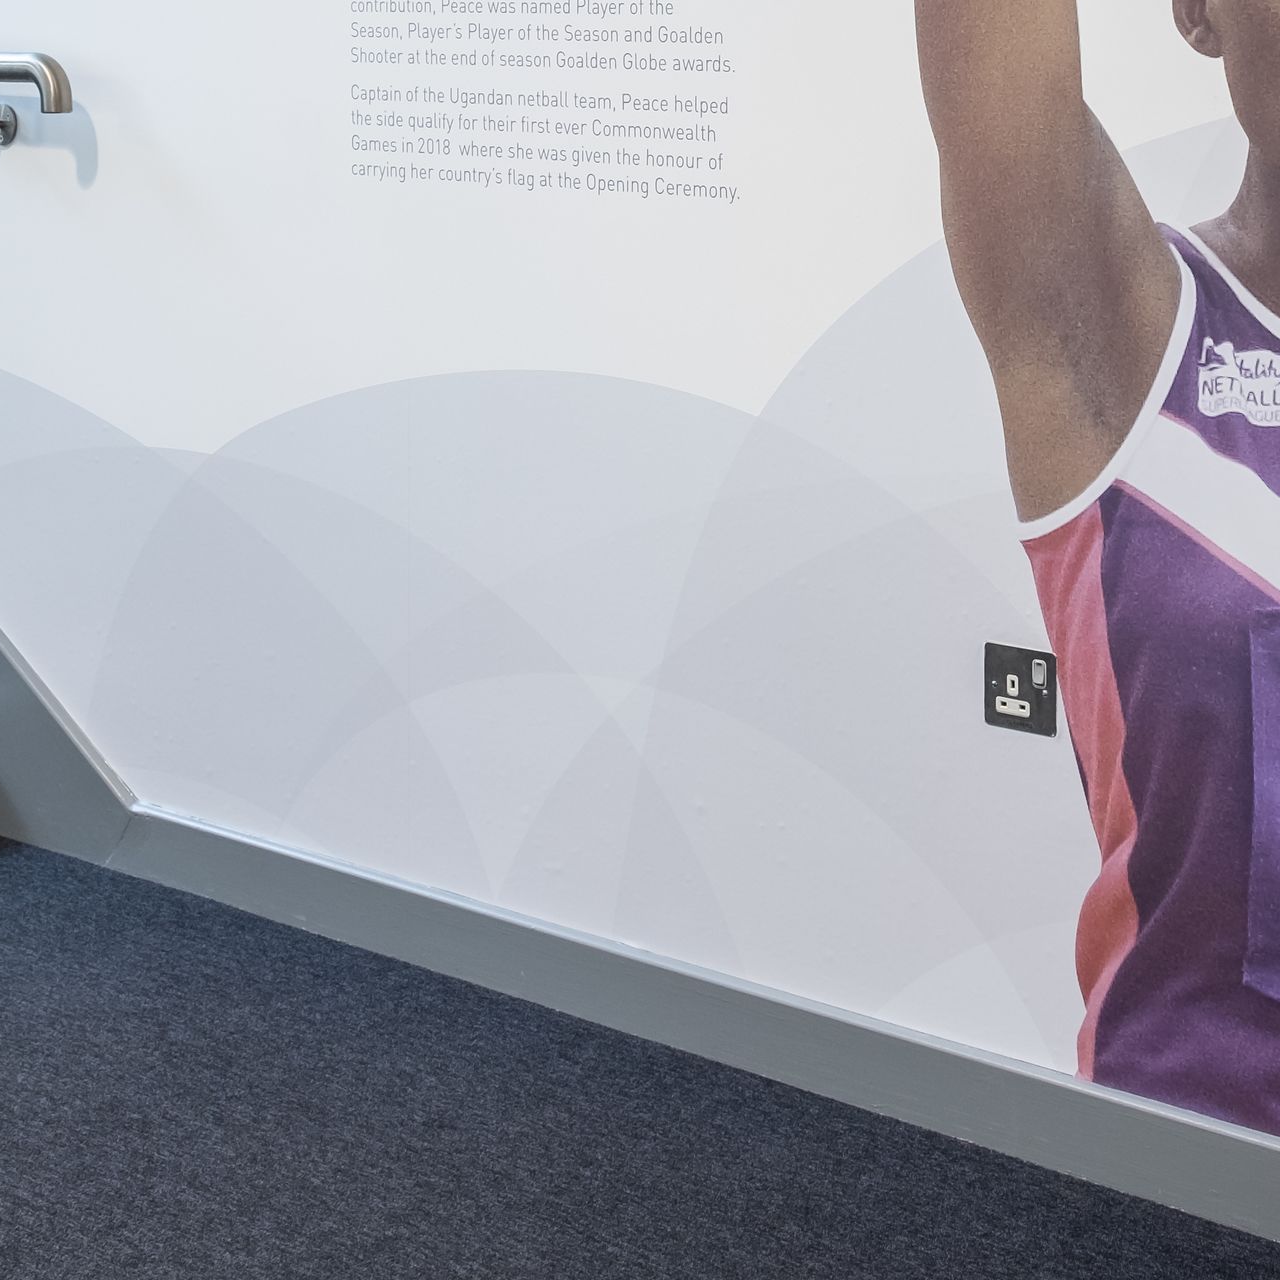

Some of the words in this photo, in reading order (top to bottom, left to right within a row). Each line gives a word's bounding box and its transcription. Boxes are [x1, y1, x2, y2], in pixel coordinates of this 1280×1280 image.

[487, 1, 517, 14] was
[350, 21, 403, 41] Season,
[468, 22, 515, 45] Player
[517, 23, 532, 41] of
[535, 23, 560, 42] the
[563, 23, 619, 43] Season
[623, 25, 653, 44] and
[657, 25, 724, 45] Goalden
[350, 46, 404, 65] Shooter
[407, 49, 421, 65] at
[424, 48, 447, 66] the
[451, 48, 477, 66] end
[481, 48, 495, 67] of
[499, 54, 551, 68] season
[556, 50, 618, 70] Goalden
[622, 52, 668, 72] Globe
[672, 54, 737, 74] awards.
[350, 83, 402, 106] Captain
[405, 85, 420, 103] of
[422, 85, 445, 104] the
[449, 87, 513, 109] Ugandan
[517, 89, 569, 109] netball
[573, 92, 616, 113] team,
[621, 92, 669, 113] Peace
[674, 94, 728, 119] helped
[351, 108, 373, 126] the
[375, 110, 404, 128] side
[407, 112, 455, 135] qualify
[458, 113, 479, 132] for
[482, 114, 517, 133] their
[521, 115, 551, 134] first
[554, 121, 588, 136] ever
[591, 118, 716, 143] Commonwealth
[351, 134, 399, 153] Games
[401, 136, 414, 154] in
[458, 139, 504, 159] where
[506, 141, 534, 160] she
[537, 147, 568, 162] was
[571, 145, 611, 168] given
[616, 147, 641, 166] the
[645, 148, 704, 169] honour
[708, 152, 724, 171] of
[351, 160, 407, 184] carrying
[410, 162, 435, 180] her
[507, 167, 535, 192] flag
[539, 171, 553, 188] at
[557, 170, 582, 190] the
[586, 173, 649, 199] Opening
[654, 176, 741, 205] Ceremony.
